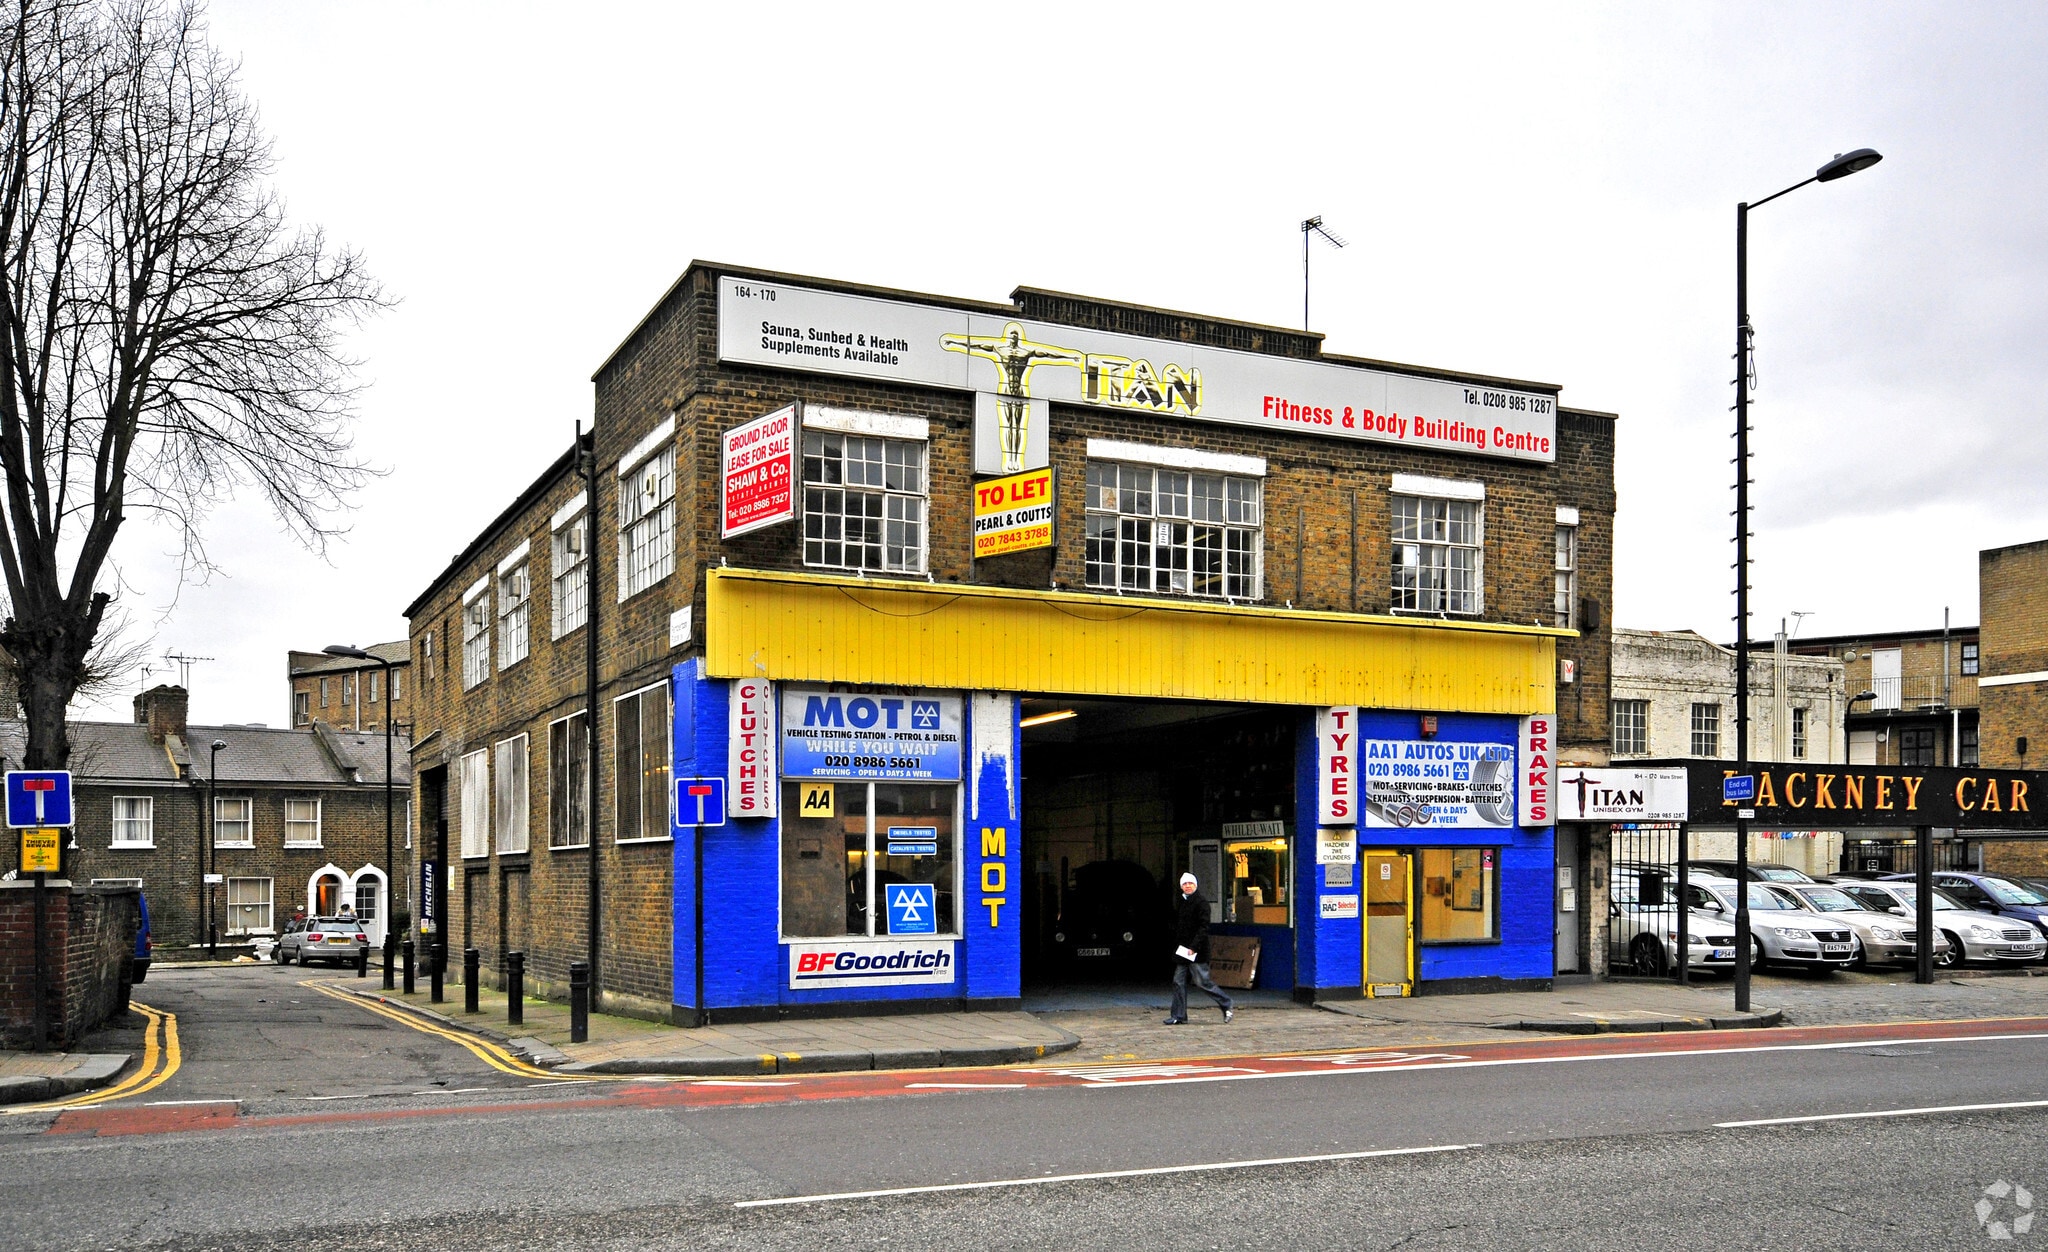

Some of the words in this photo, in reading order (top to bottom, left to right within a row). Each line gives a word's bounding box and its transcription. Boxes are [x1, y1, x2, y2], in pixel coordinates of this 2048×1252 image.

[734, 285, 751, 299] 164
[760, 289, 776, 302] 170
[761, 321, 803, 341] Sauna,
[808, 327, 852, 345] Sunbed
[857, 334, 866, 346] &
[870, 336, 908, 352] Health
[761, 337, 840, 359] Supplements
[844, 347, 899, 365] Available
[1463, 389, 1480, 405] Tel.
[1483, 391, 1506, 409] 0208
[1509, 395, 1526, 411] 985
[1529, 397, 1551, 414] 1287
[728, 428, 760, 452] GROUND
[762, 417, 788, 439] FLOOR
[1263, 396, 1333, 426] Fitness
[1342, 407, 1355, 428] &
[1363, 409, 1407, 439] Body
[1414, 416, 1486, 449] Building
[1493, 426, 1550, 453] Centre
[727, 452, 750, 472] LEASE
[752, 445, 767, 463] FOR
[769, 437, 789, 457] SALE
[728, 469, 758, 493] SHAW
[760, 466, 768, 482] &
[771, 462, 788, 478] Co.
[728, 489, 754, 504] ESTATE
[759, 476, 788, 492] AGENTS
[728, 509, 739, 519] Tel:
[739, 504, 752, 516] 020
[753, 498, 770, 511] 8986
[771, 492, 788, 505] 7327
[978, 486, 1004, 507] TO
[1011, 477, 1049, 502] LET
[976, 515, 1004, 532] PEARL
[1006, 514, 1013, 526] &
[1016, 506, 1051, 524] COUTTS
[978, 536, 995, 548] 020
[998, 531, 1022, 545] 7843
[1024, 527, 1048, 540] 3788
[803, 695, 905, 730] MOT
[740, 685, 756, 810] CLUTCHES
[786, 729, 818, 739] VEHICLE
[820, 730, 852, 739] TESTING
[854, 731, 886, 740] STATION
[894, 732, 922, 742] PETROL
[924, 734, 930, 742] &
[933, 734, 957, 742] DIESEL
[806, 739, 857, 754] WHILE
[862, 741, 895, 755] YOU
[896, 742, 938, 756] WAIT
[825, 755, 849, 767] 020
[854, 756, 886, 768] 8986
[890, 757, 921, 769] 5661
[1331, 711, 1350, 817] TYRES
[1368, 743, 1398, 759] AA1
[1405, 744, 1454, 760] AUTOS
[1459, 745, 1479, 761] UK
[1485, 747, 1510, 761] LTD
[812, 768, 851, 776] SERVICING
[858, 769, 878, 777] OPEN
[886, 769, 904, 777] DAYS
[912, 770, 932, 778] WEEK
[1368, 763, 1389, 776] 020
[1393, 764, 1420, 777] 8986
[1423, 765, 1449, 777] 5661
[1529, 720, 1549, 820] BRAKES
[804, 790, 830, 809] AA
[1956, 777, 2030, 813] CAR
[1422, 806, 1442, 814] OPEN
[1439, 816, 1458, 824] WEEK
[425, 863, 433, 917] MICHELIN
[981, 827, 1006, 928] MOT
[1322, 903, 1337, 912] RAC
[1338, 901, 1357, 909] Selected
[797, 950, 950, 973] BFGoodrich
